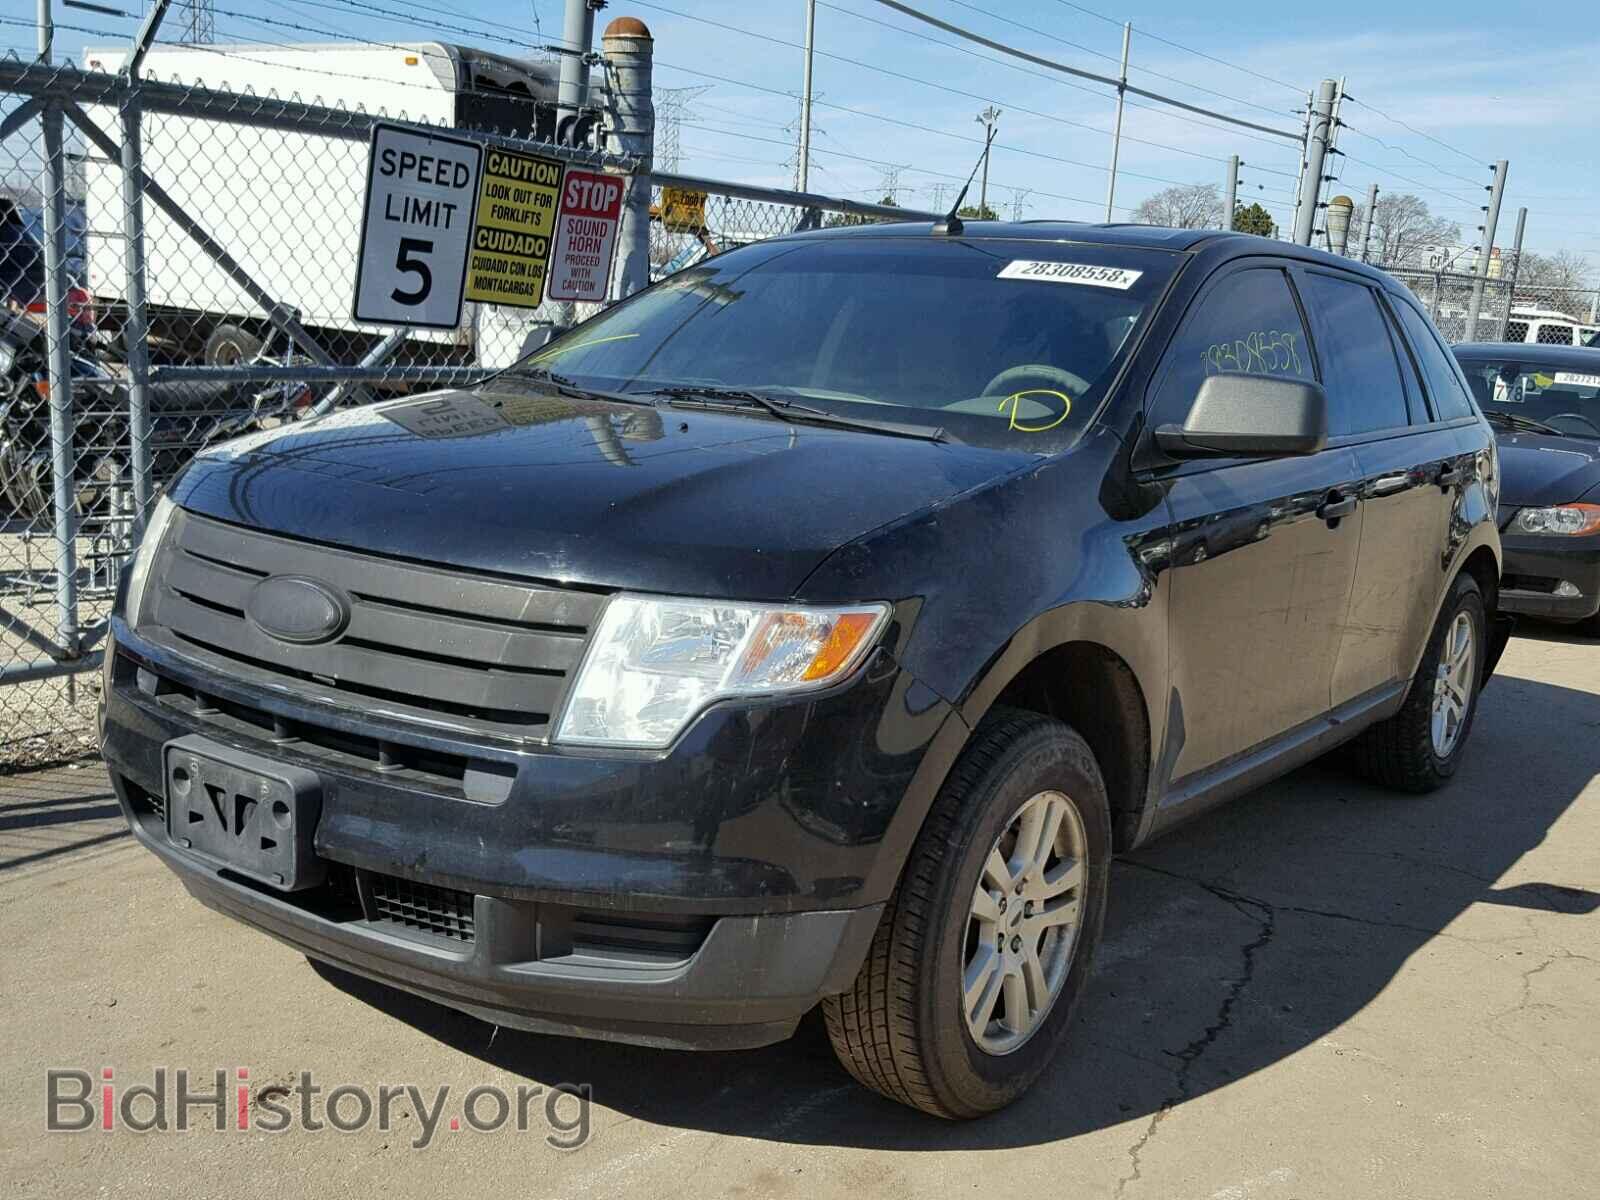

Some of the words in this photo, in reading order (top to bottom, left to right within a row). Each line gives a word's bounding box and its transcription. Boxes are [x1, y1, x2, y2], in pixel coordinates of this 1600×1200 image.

[380, 149, 469, 189] SPEED
[488, 153, 560, 185] CAUTION
[485, 183, 510, 200] LOOK
[513, 188, 532, 205] OUT
[534, 192, 553, 208] FOR
[567, 179, 618, 212] STOP
[385, 194, 457, 229] LIMIT
[491, 204, 542, 226] FORKLIFTS
[567, 218, 608, 238] SOUND
[477, 229, 546, 256] CUIDADO
[569, 236, 601, 254] HORN
[391, 237, 433, 305] 5
[472, 255, 507, 274] CUIDADO
[509, 259, 526, 276] CON
[528, 263, 542, 278] LOS
[565, 253, 600, 267] PROCEED
[571, 267, 591, 279] WITH
[473, 276, 535, 296] MONTACARGAS
[562, 279, 595, 292] CAUTION
